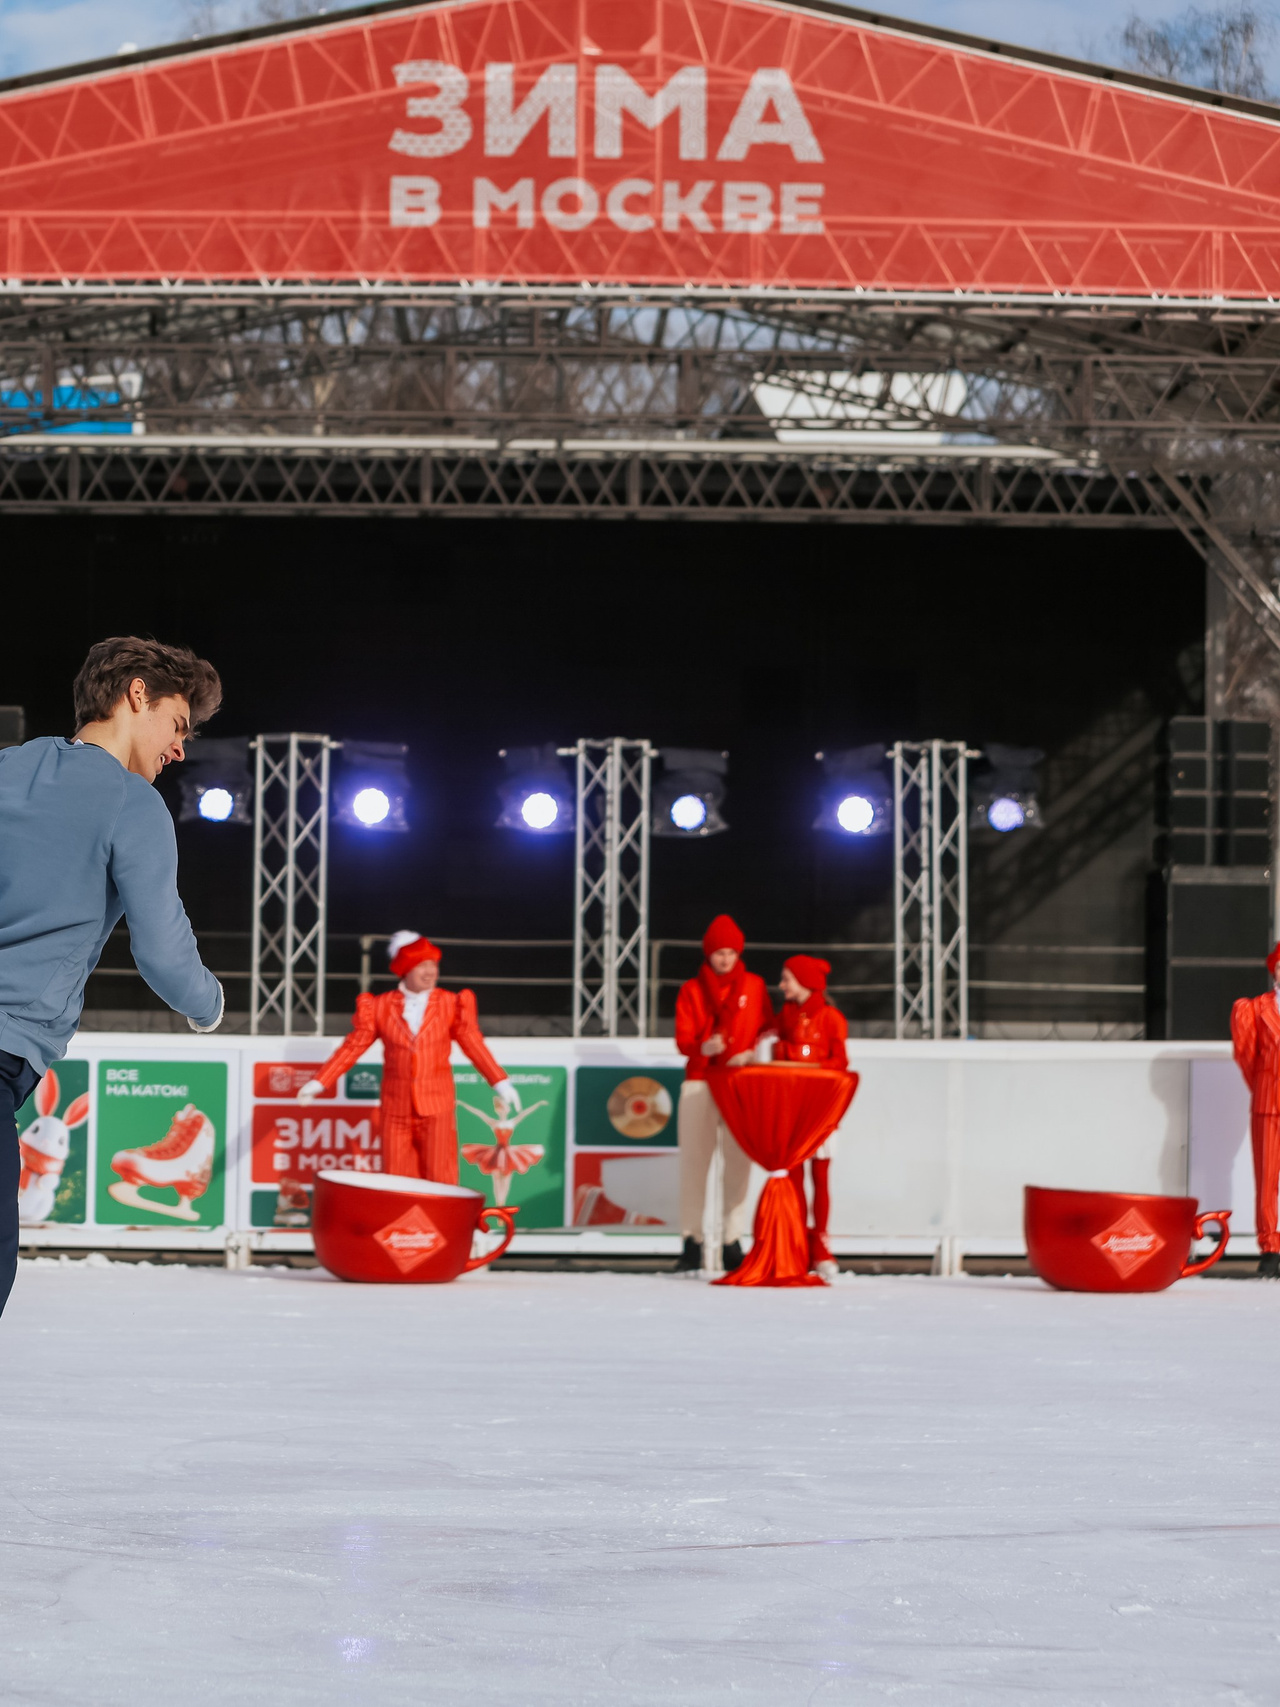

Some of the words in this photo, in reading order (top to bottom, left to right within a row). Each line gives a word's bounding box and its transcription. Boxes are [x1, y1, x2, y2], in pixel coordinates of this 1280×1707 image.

[388, 59, 825, 163] ЗИМА
[389, 175, 443, 229] В
[472, 177, 826, 234] МОСКВЕ
[106, 1068, 139, 1082] ВСЕ
[105, 1083, 130, 1097] НА
[131, 1083, 189, 1098] КАТОК!
[272, 1152, 291, 1171] В
